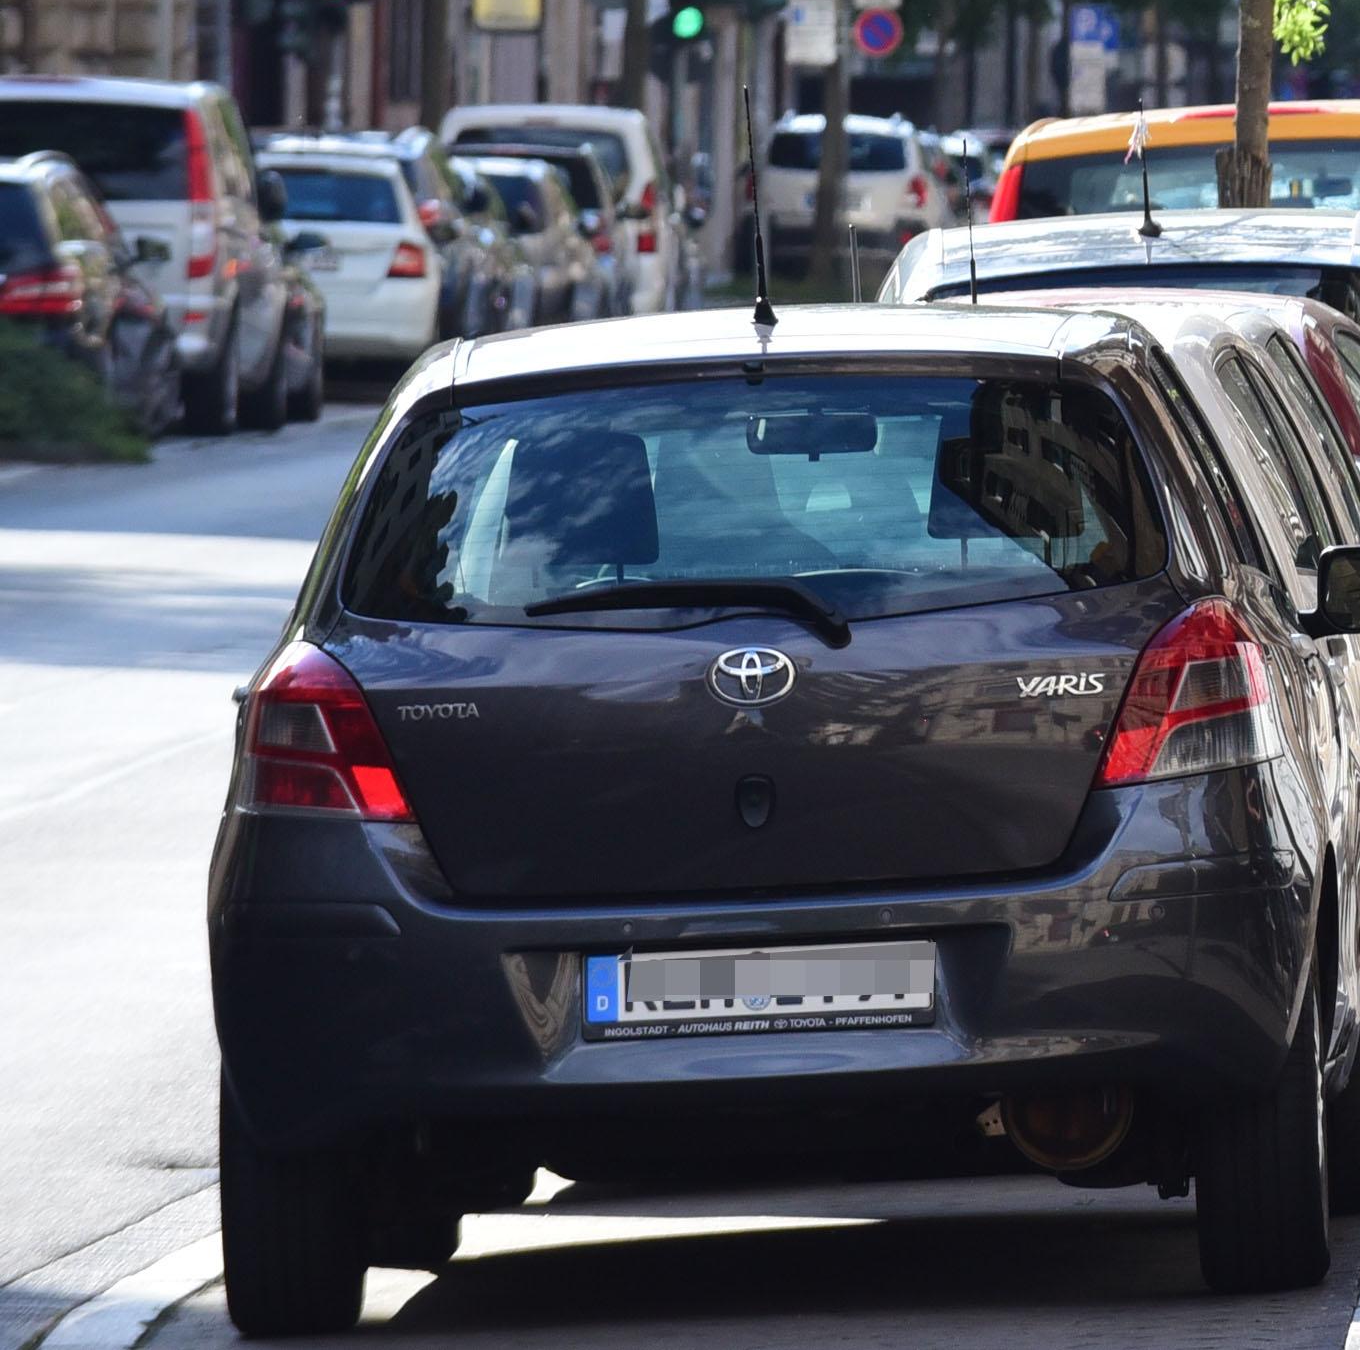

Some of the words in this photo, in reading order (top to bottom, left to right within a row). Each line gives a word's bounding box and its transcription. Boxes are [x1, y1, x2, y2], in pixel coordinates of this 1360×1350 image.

[397, 702, 480, 722] TOYOTA
[596, 995, 609, 1011] D
[604, 1025, 668, 1037] INGOLSTADT
[677, 1021, 732, 1034] AUTOHAUS
[734, 1019, 770, 1030] REITH
[790, 1017, 826, 1028] TOYOTA
[835, 1014, 912, 1026] PFAFFENHOFEN
